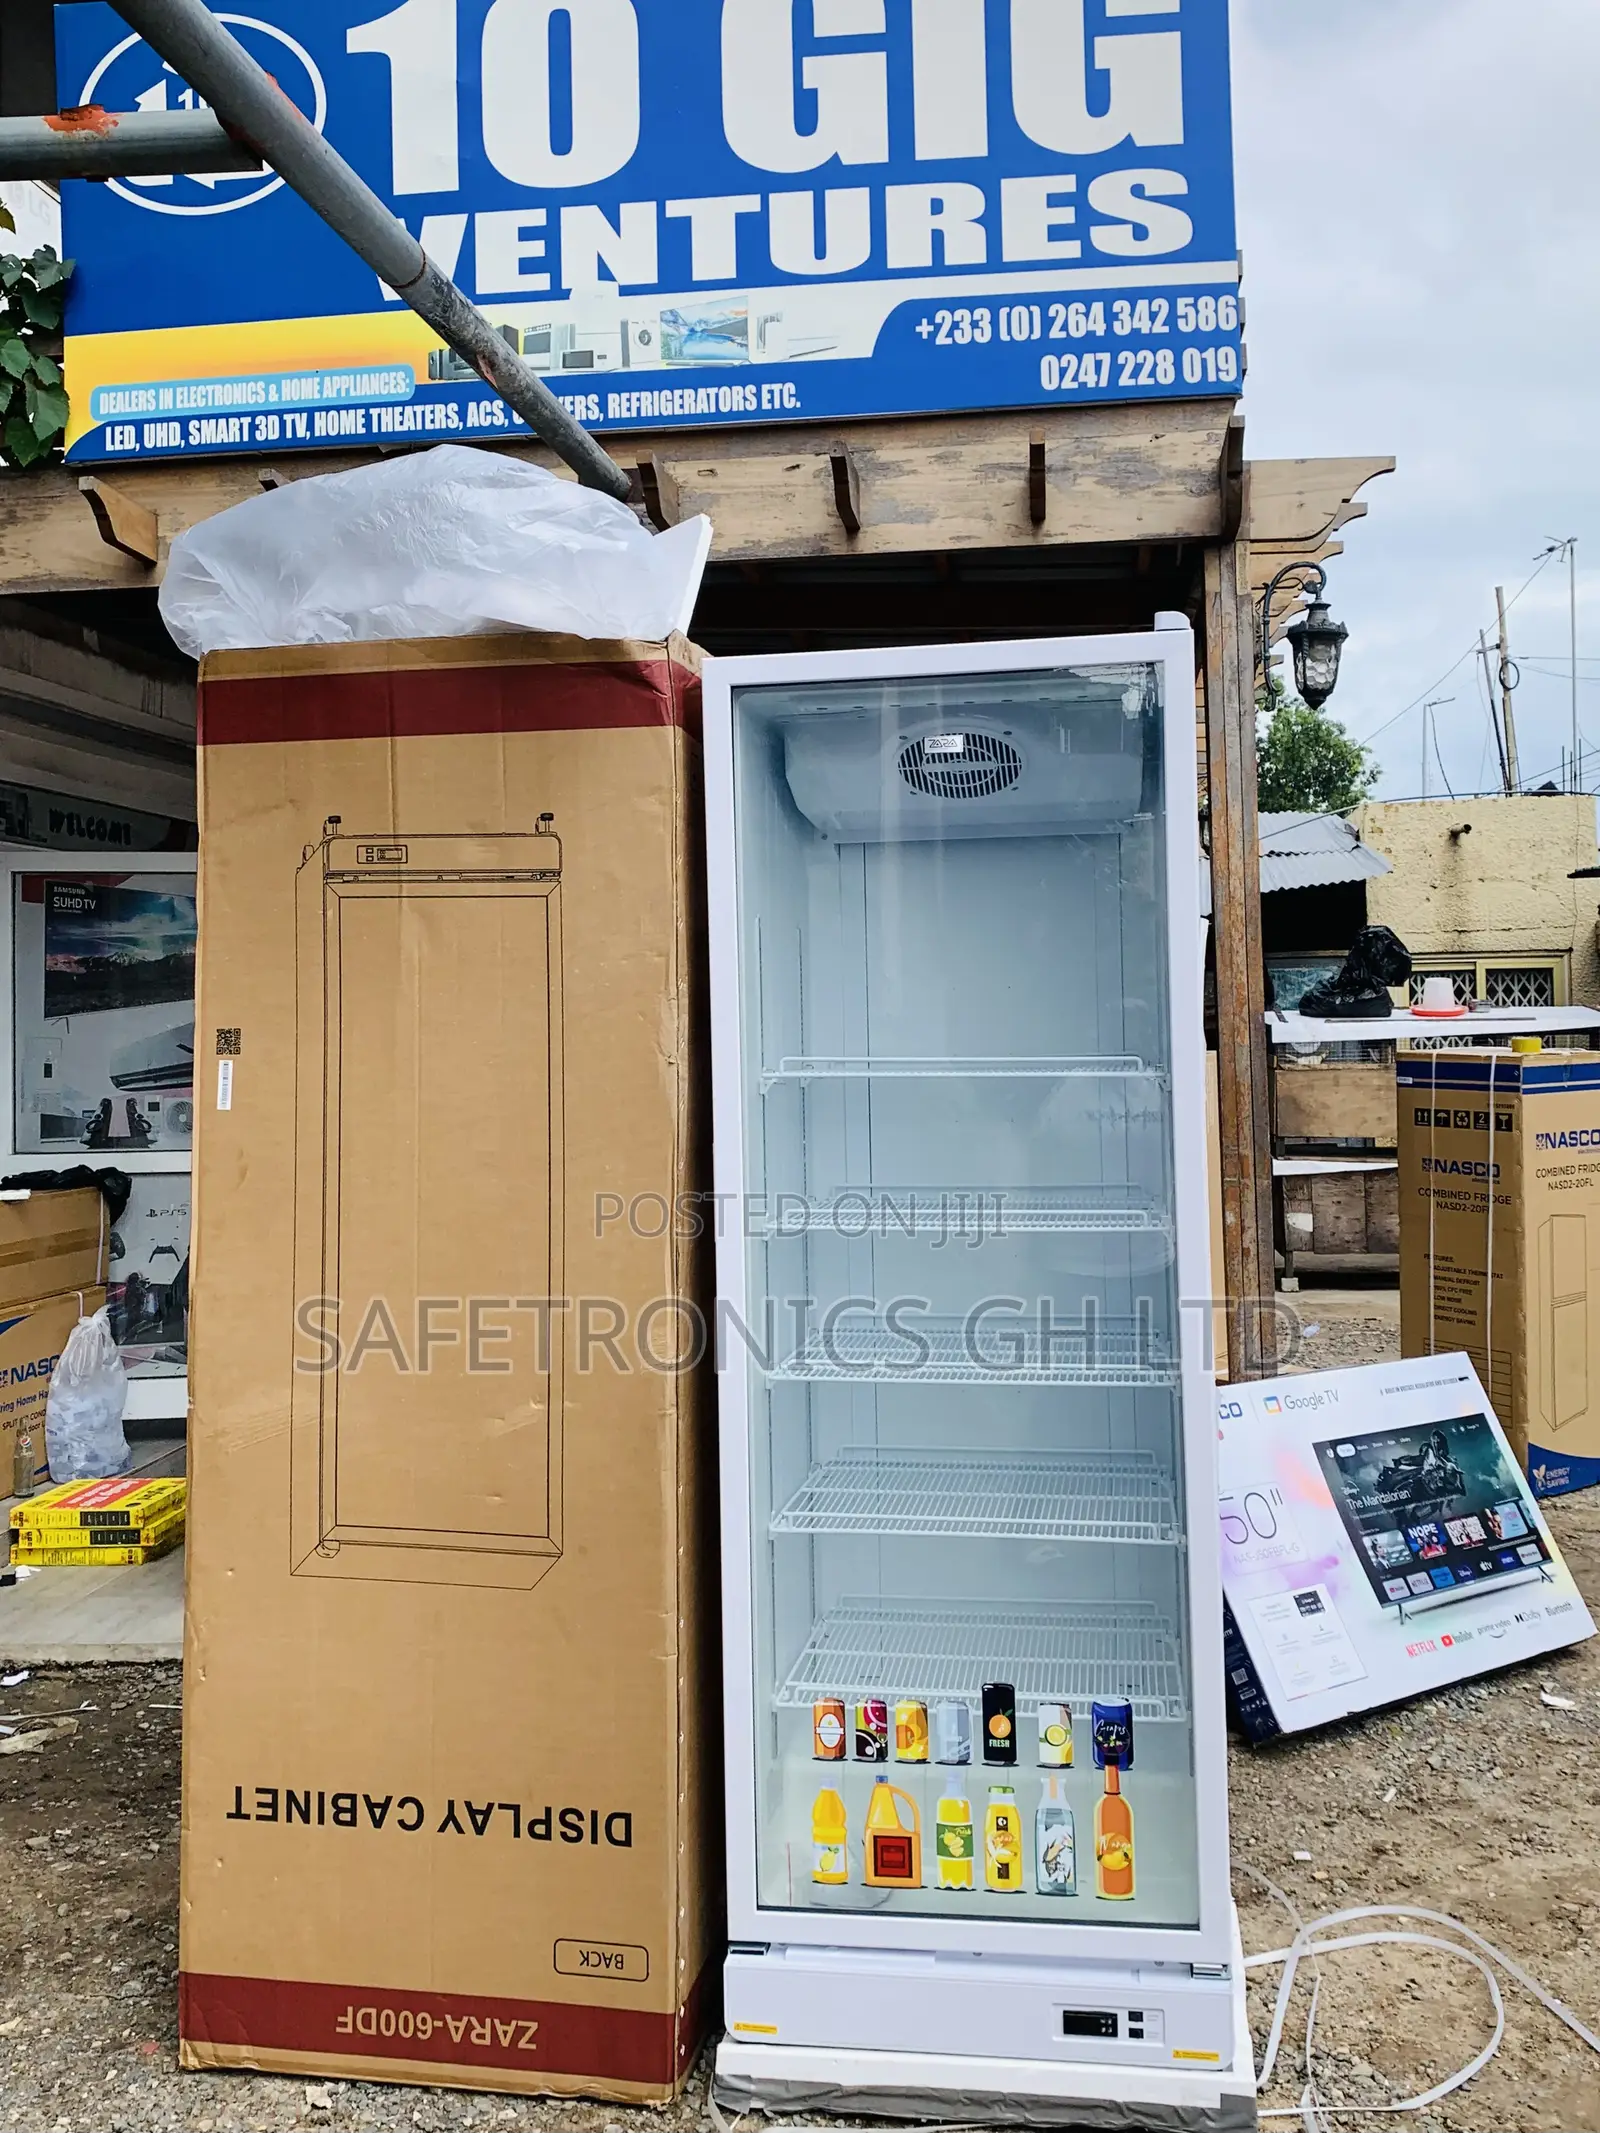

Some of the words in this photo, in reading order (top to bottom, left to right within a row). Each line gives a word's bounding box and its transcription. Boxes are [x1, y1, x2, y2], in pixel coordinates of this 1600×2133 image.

[346, 0, 641, 196] 10
[720, 0, 1185, 174] GIG
[915, 307, 992, 346] +233
[998, 304, 1042, 342] (0)
[1048, 301, 1106, 339] 264
[1112, 297, 1170, 336] 342
[1176, 294, 1238, 333] 586
[1040, 352, 1111, 391] 0247
[1117, 348, 1175, 387] 228
[1182, 345, 1237, 384] 019
[100, 389, 156, 415] DEALERS
[159, 387, 174, 410] IN
[176, 381, 266, 409] ELECTRONICS
[268, 383, 279, 403] &
[281, 377, 321, 401] HOME
[322, 370, 410, 400] APPLIANCES:
[105, 425, 141, 453] LED,
[143, 421, 186, 449] UHD,
[189, 416, 252, 446] SMART
[254, 414, 280, 442] 3D
[283, 412, 310, 441] TV,
[314, 408, 366, 437] HOME
[370, 402, 464, 434] THEATERS,
[466, 398, 509, 429] ACS,
[607, 386, 758, 419] REFRIGERATORS
[760, 381, 801, 411] ETC.
[928, 738, 958, 748] ZARA
[53, 886, 86, 895] SAMSUNG
[53, 896, 82, 909] SUHD
[83, 899, 97, 910] TV
[1434, 1159, 1501, 1179] NASCO
[1535, 1164, 1577, 1179] COMBINED
[1578, 1162, 1600, 1174] FRIDG
[1418, 1187, 1472, 1201] COMBINED
[1547, 1177, 1594, 1191] NASD2-20FL
[160, 1208, 187, 1216] PS5
[1436, 1202, 1490, 1214] NASD2-20F
[16, 1393, 37, 1407] Home
[1284, 1391, 1325, 1411] Google
[1324, 1389, 1340, 1404] TV
[1546, 1466, 1570, 1480] ENERGY
[1346, 1499, 1364, 1511] The
[1365, 1490, 1412, 1507] Mandalorian
[1408, 1522, 1438, 1539] NOPE
[1406, 1639, 1438, 1657] NETFLIX
[1477, 1624, 1494, 1636] prime
[1494, 1618, 1511, 1629] video
[989, 1739, 1010, 1748] FRESH
[226, 1785, 425, 1832] CABINET
[436, 1799, 632, 1848] DISPLAY
[579, 1949, 624, 1970] BACK
[335, 2005, 539, 2050] ZARA-600DF
